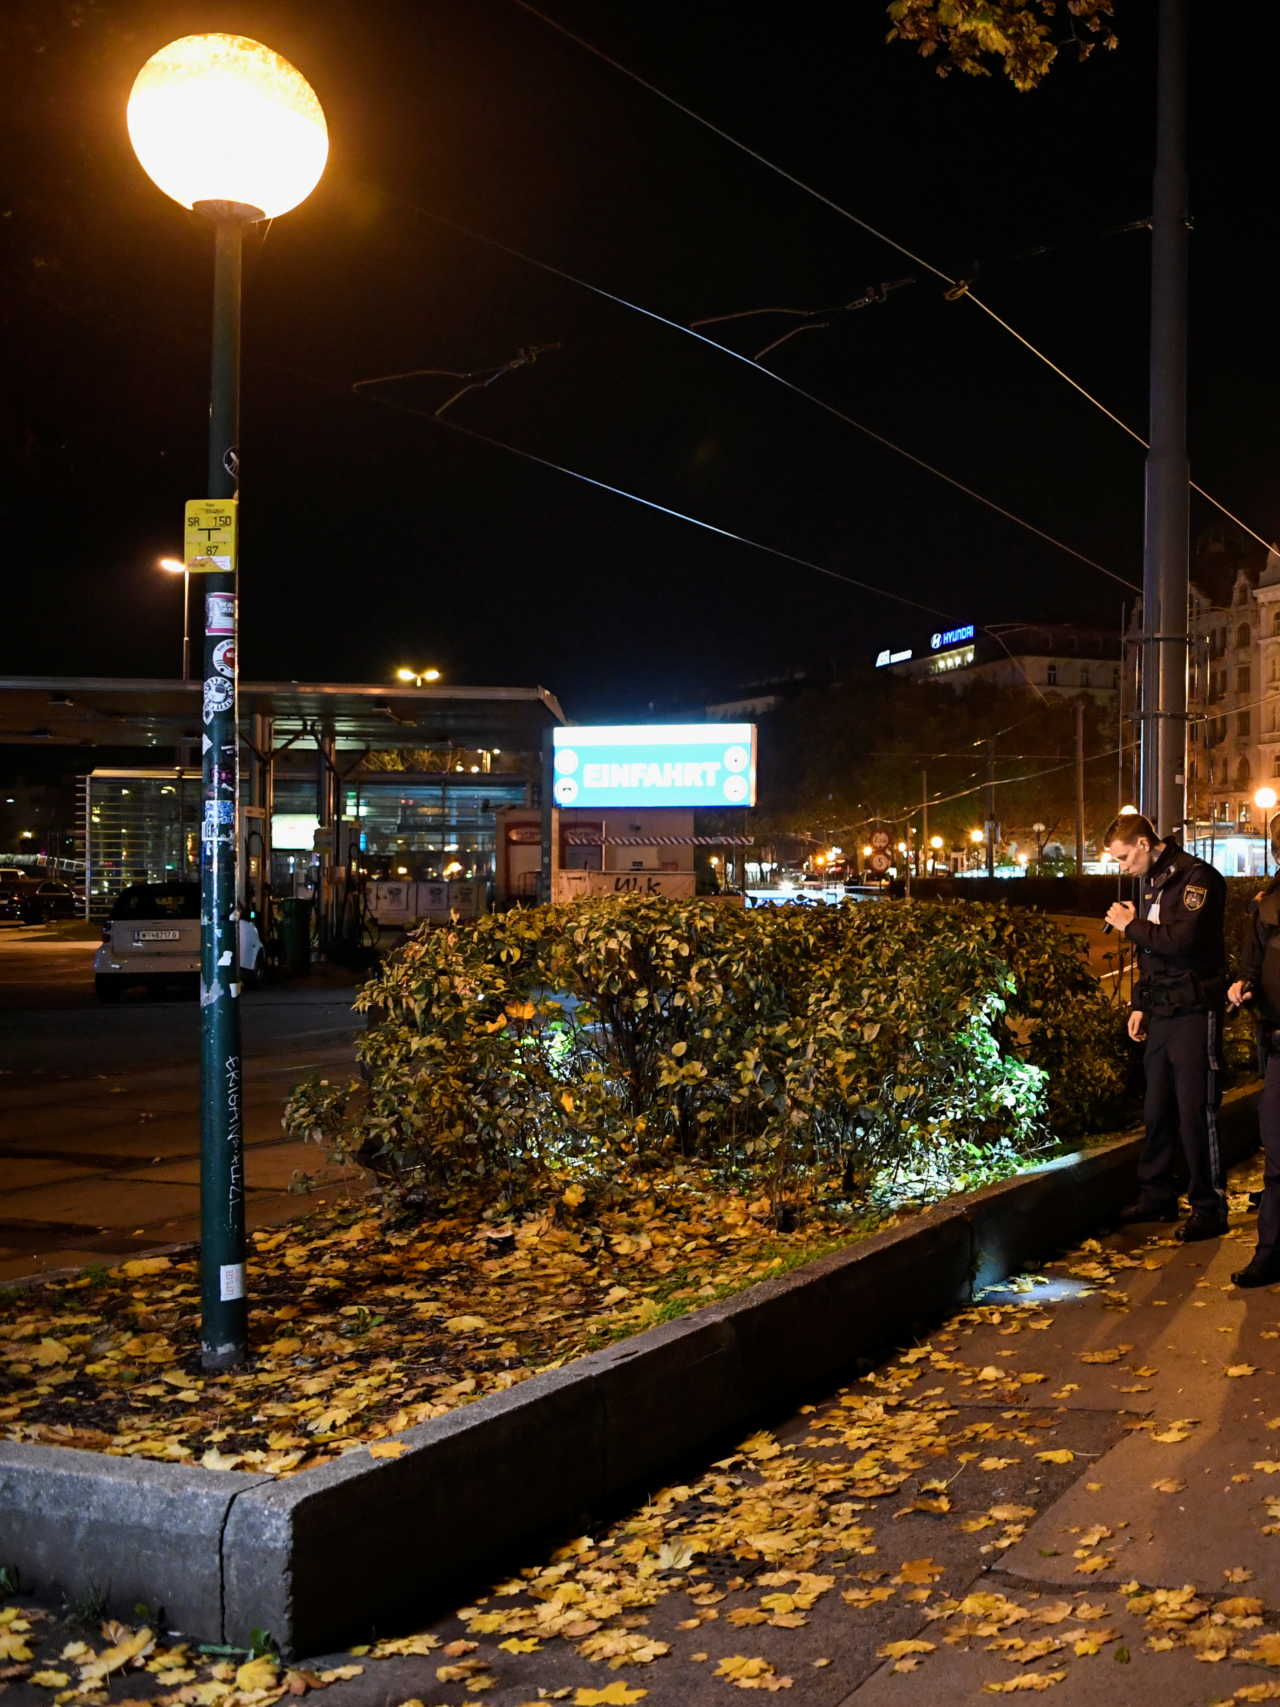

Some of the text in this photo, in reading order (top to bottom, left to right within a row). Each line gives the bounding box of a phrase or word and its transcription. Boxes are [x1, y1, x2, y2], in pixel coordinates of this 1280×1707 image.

[187, 515, 232, 527] SR 150
[942, 625, 975, 646] HYUNDAI
[583, 761, 721, 789] EINFAHRT
